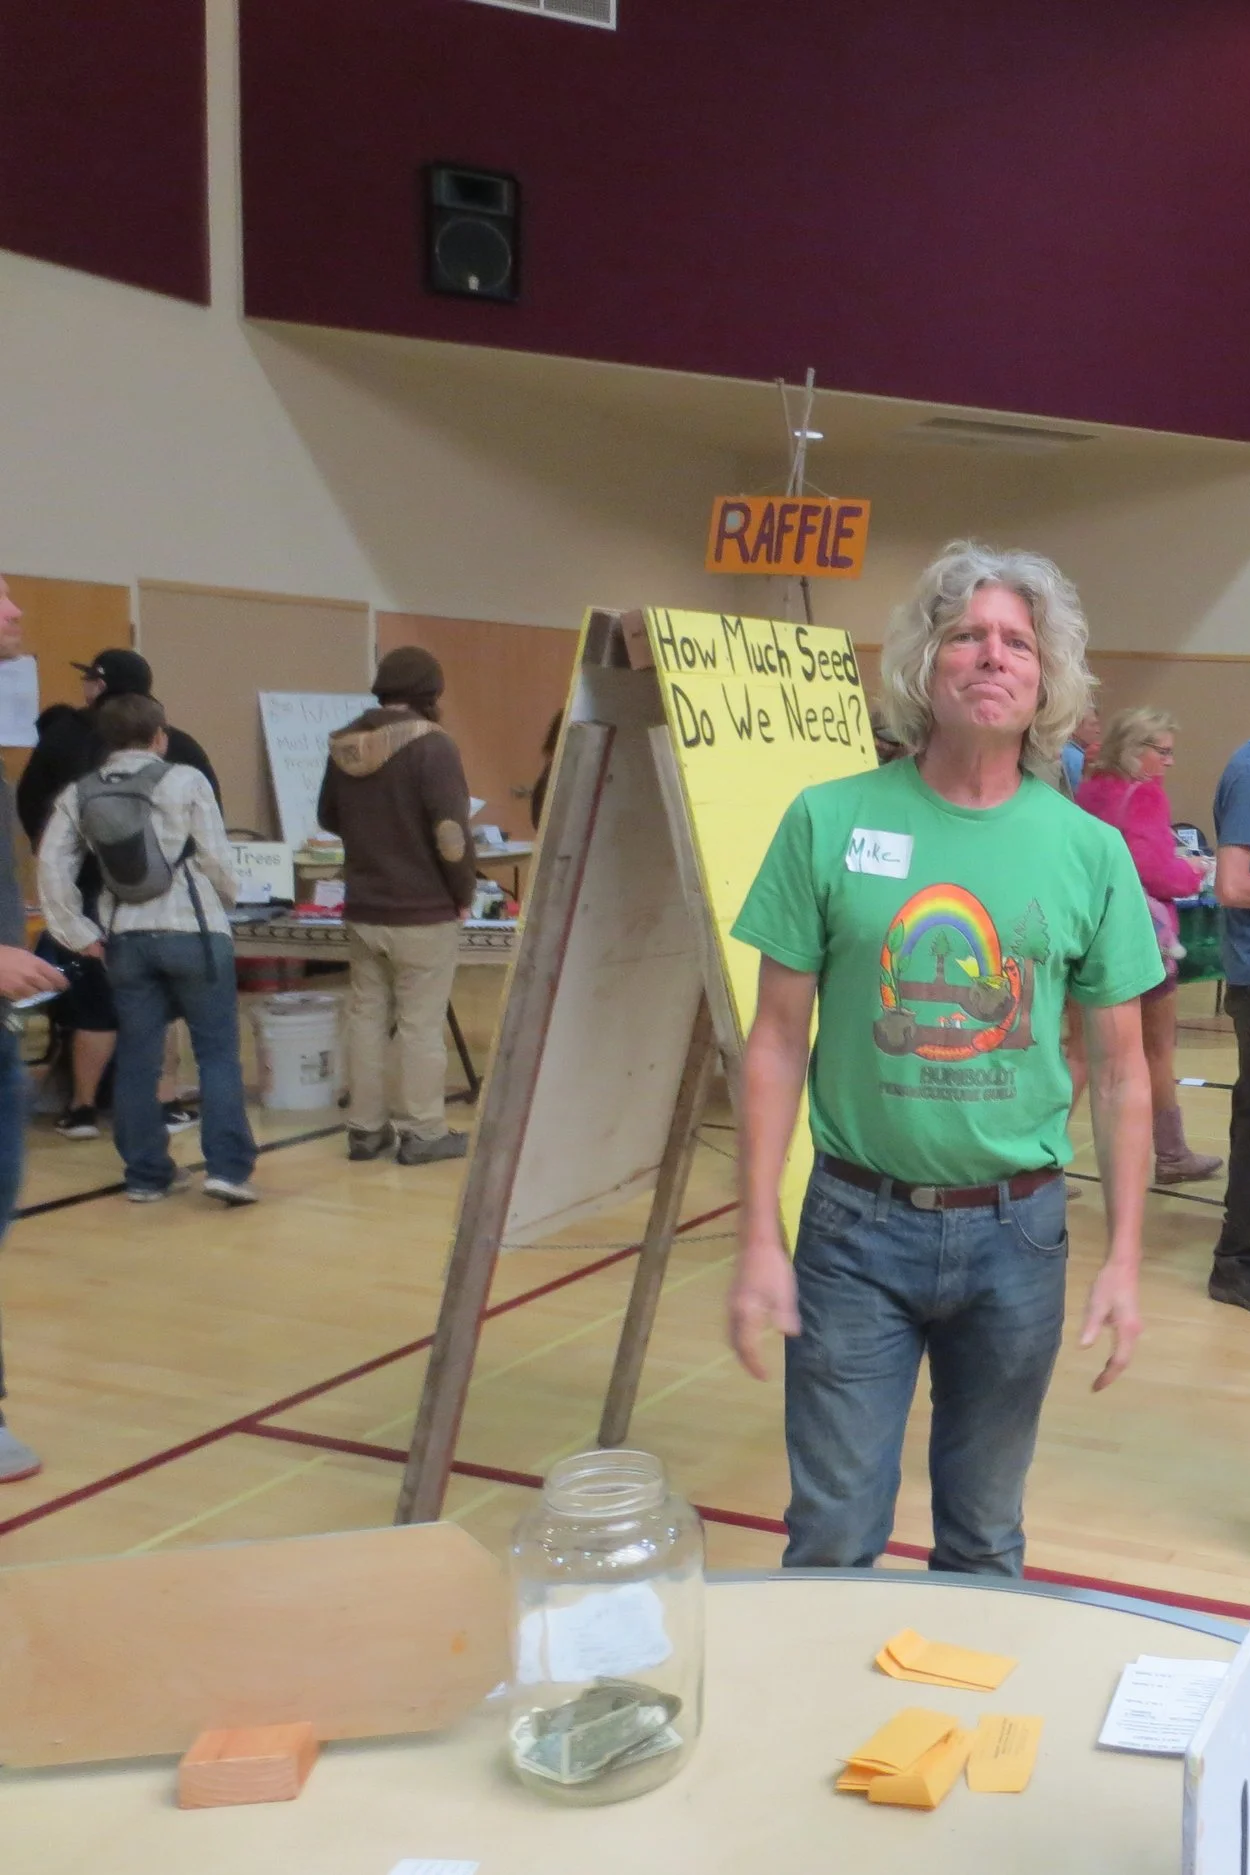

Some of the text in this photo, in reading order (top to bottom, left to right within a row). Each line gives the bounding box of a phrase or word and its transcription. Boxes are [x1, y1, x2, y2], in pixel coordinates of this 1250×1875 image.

[714, 500, 863, 569] RAFFLE
[651, 608, 860, 687] How Much Seed
[671, 681, 867, 755] Do We Need?
[231, 845, 282, 866] Trees
[848, 836, 901, 865] Mike
